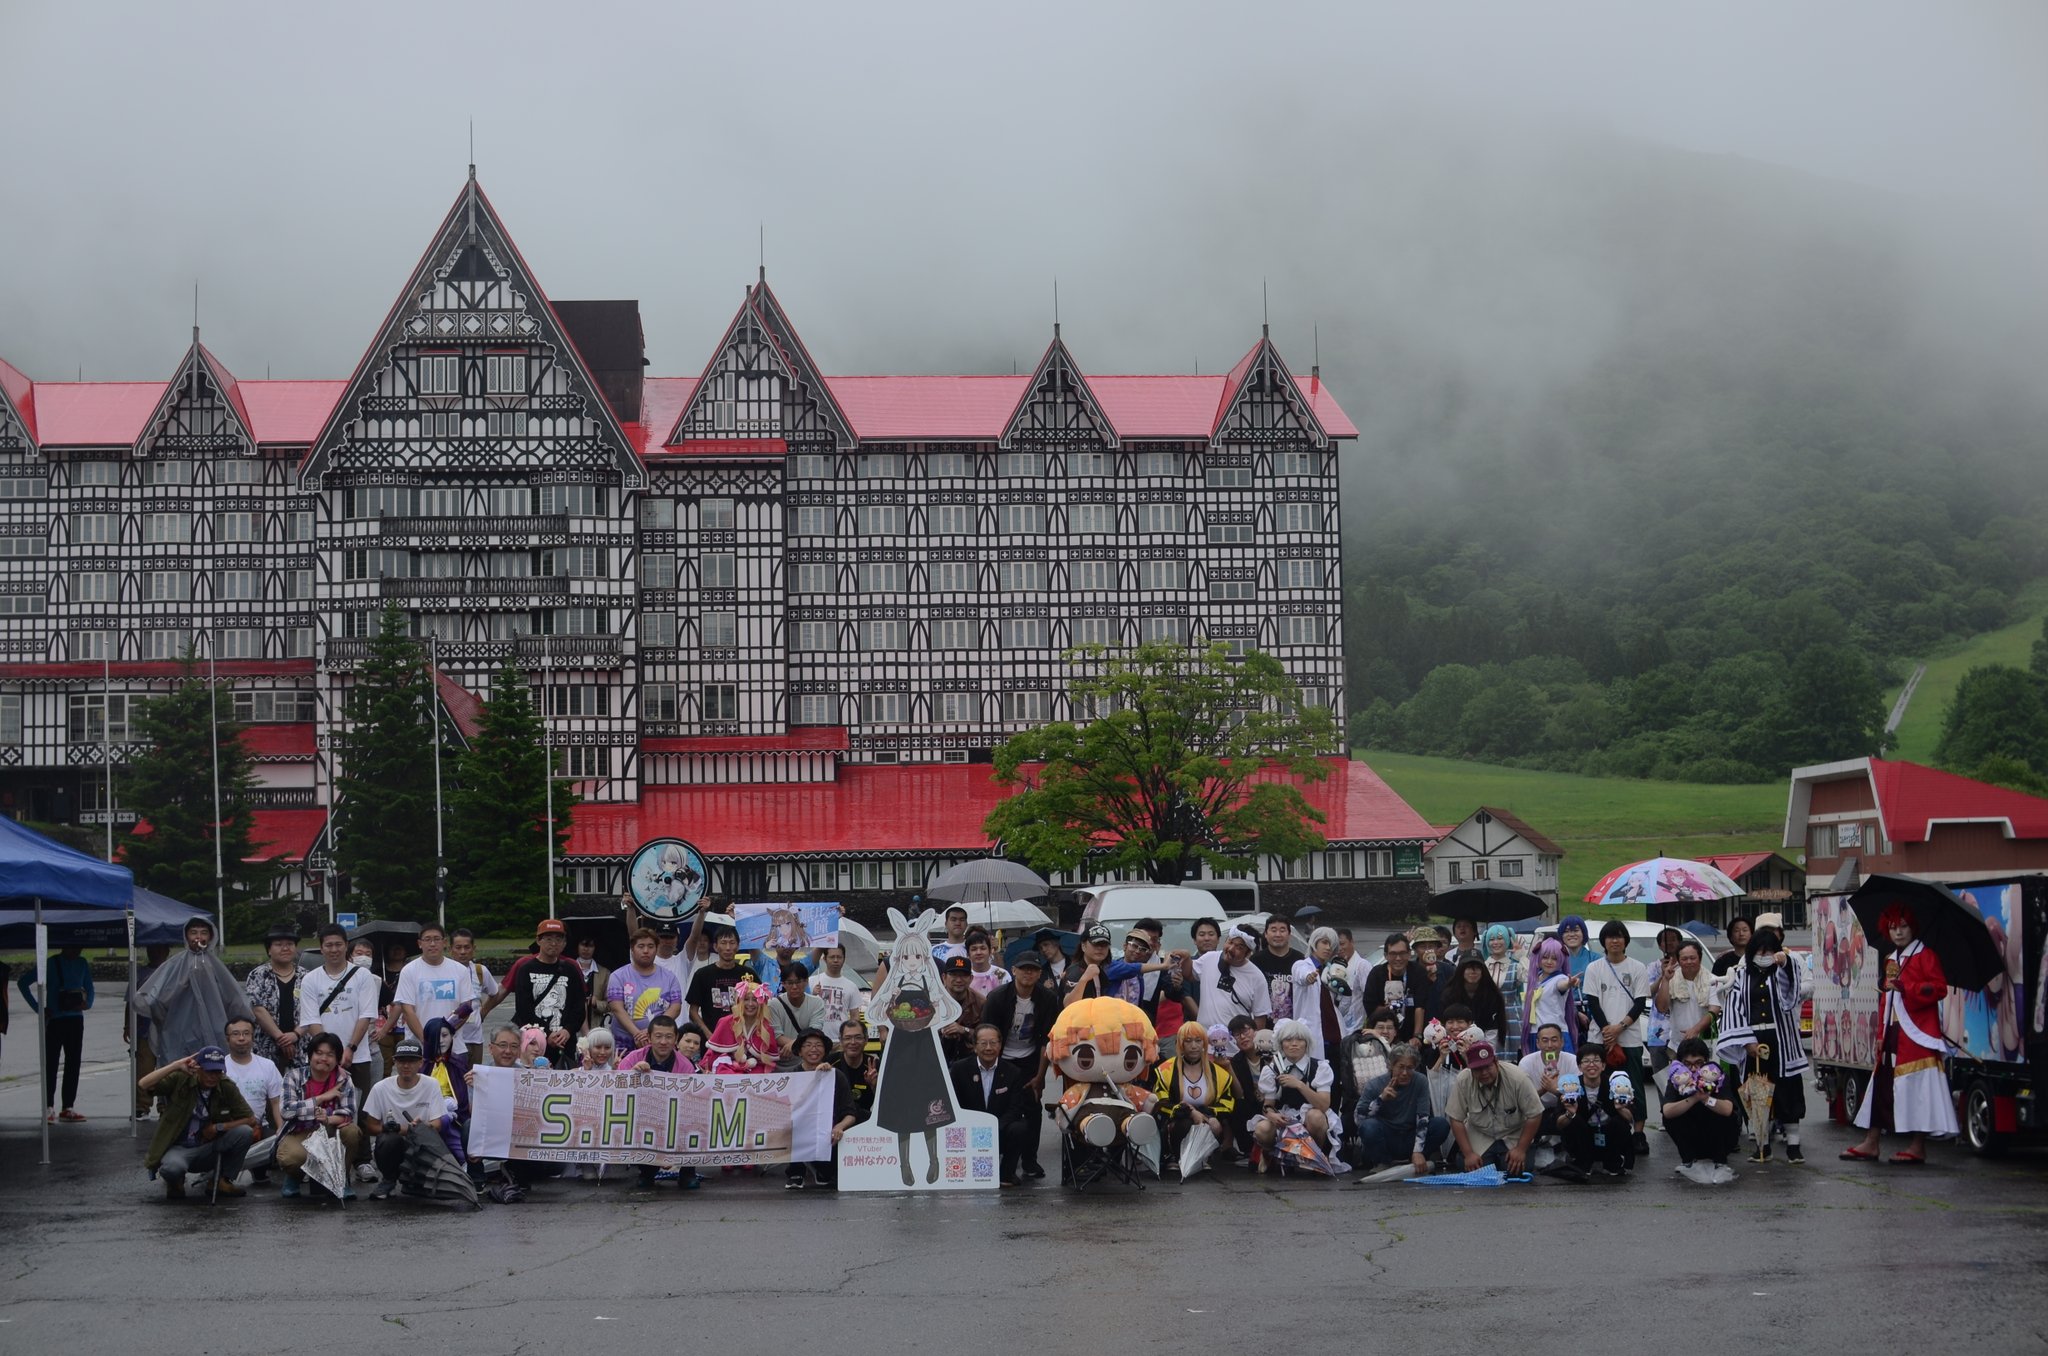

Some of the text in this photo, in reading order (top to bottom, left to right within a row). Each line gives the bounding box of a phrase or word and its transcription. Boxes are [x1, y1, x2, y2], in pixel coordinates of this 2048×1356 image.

[712, 1076, 790, 1093] ミーティング
[540, 1094, 765, 1149] S.H.I.M.
[857, 1145, 883, 1153] VTuber
[843, 1155, 897, 1167] 信州なかの
